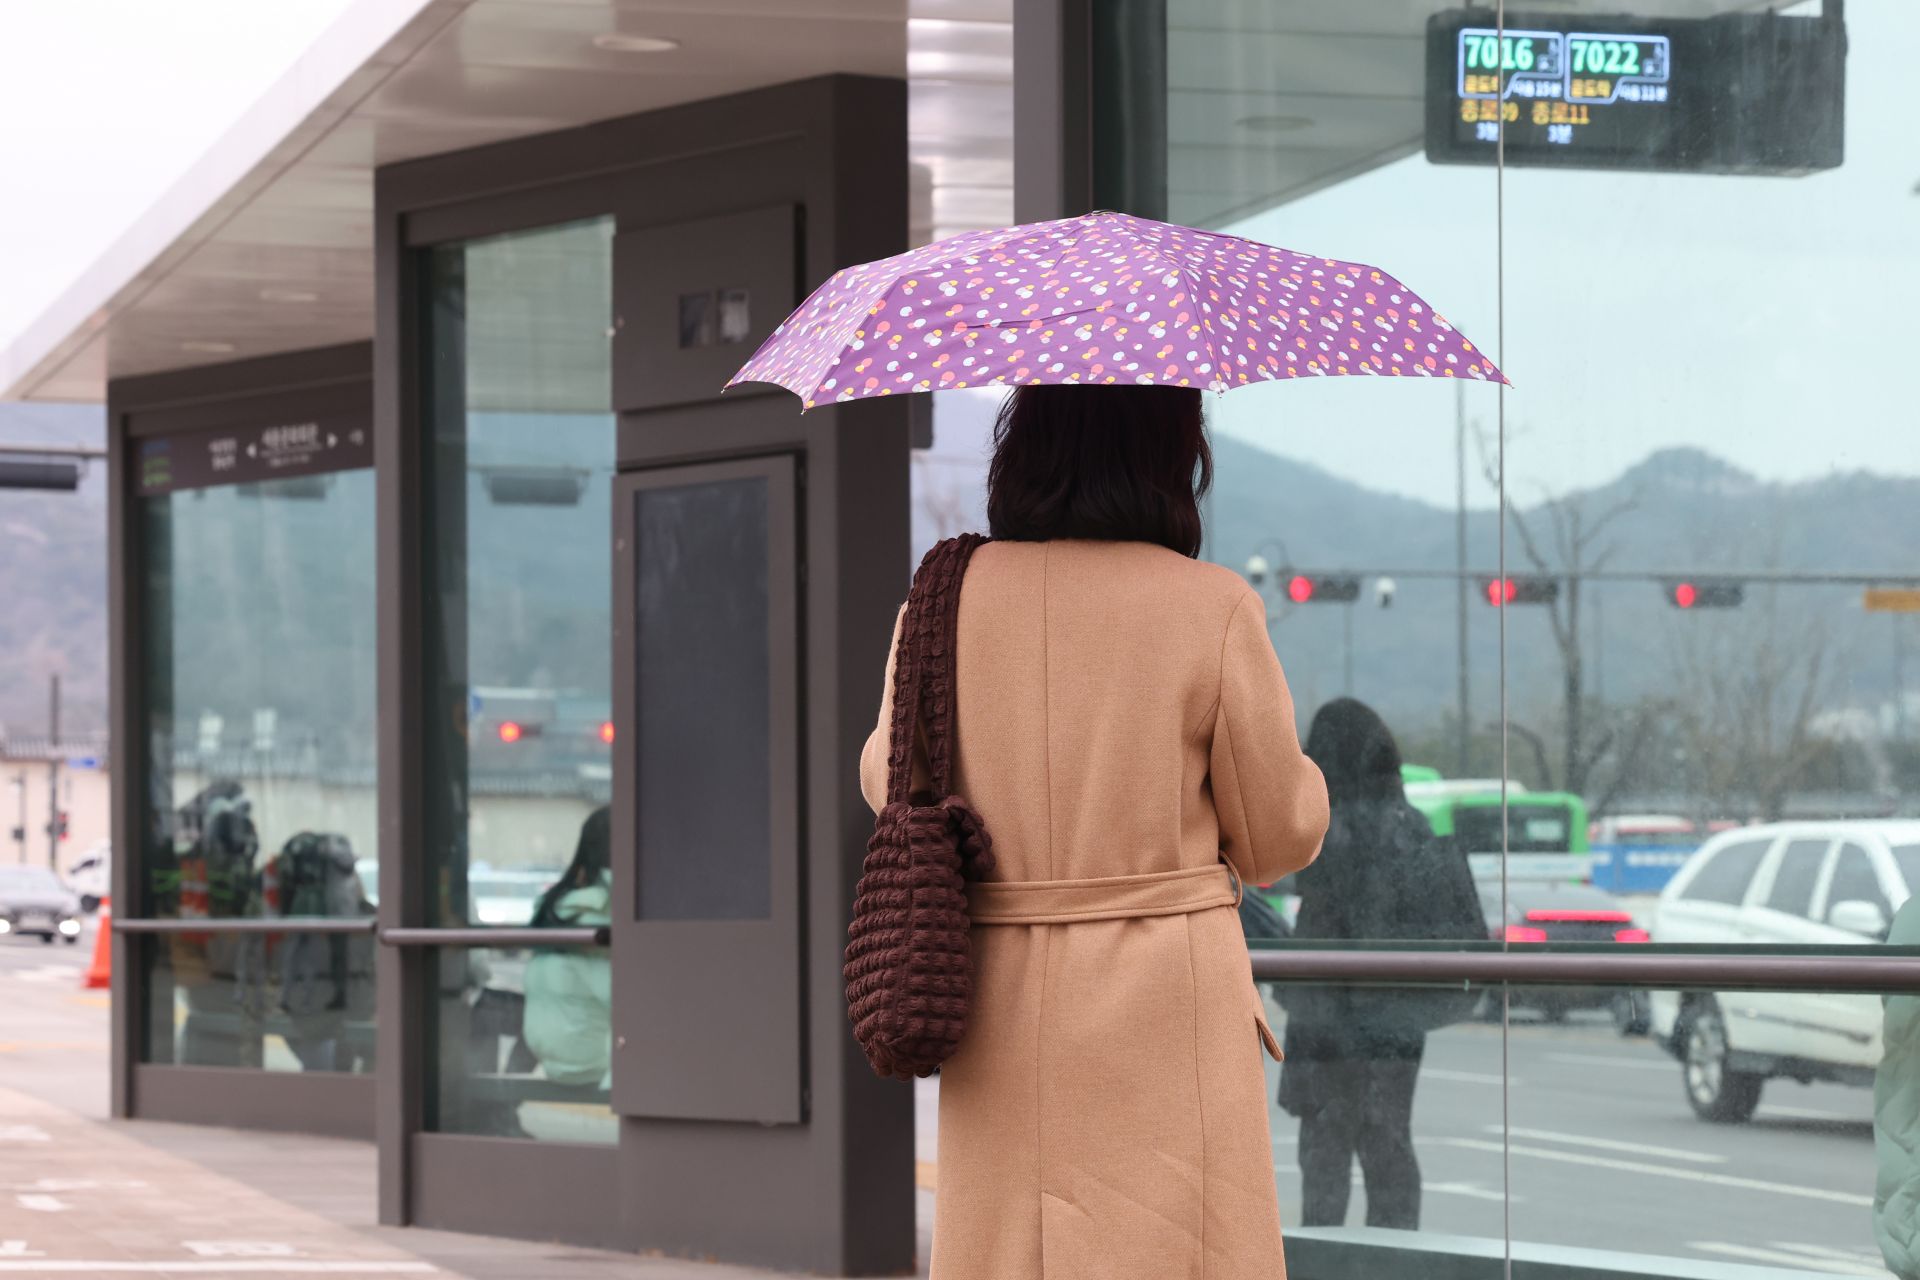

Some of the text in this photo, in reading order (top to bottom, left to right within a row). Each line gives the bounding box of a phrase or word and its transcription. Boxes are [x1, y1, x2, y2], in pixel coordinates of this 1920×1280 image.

[1465, 36, 1534, 70] 7016
[1571, 40, 1640, 74] 7022
[1532, 101, 1590, 125] 종로11
